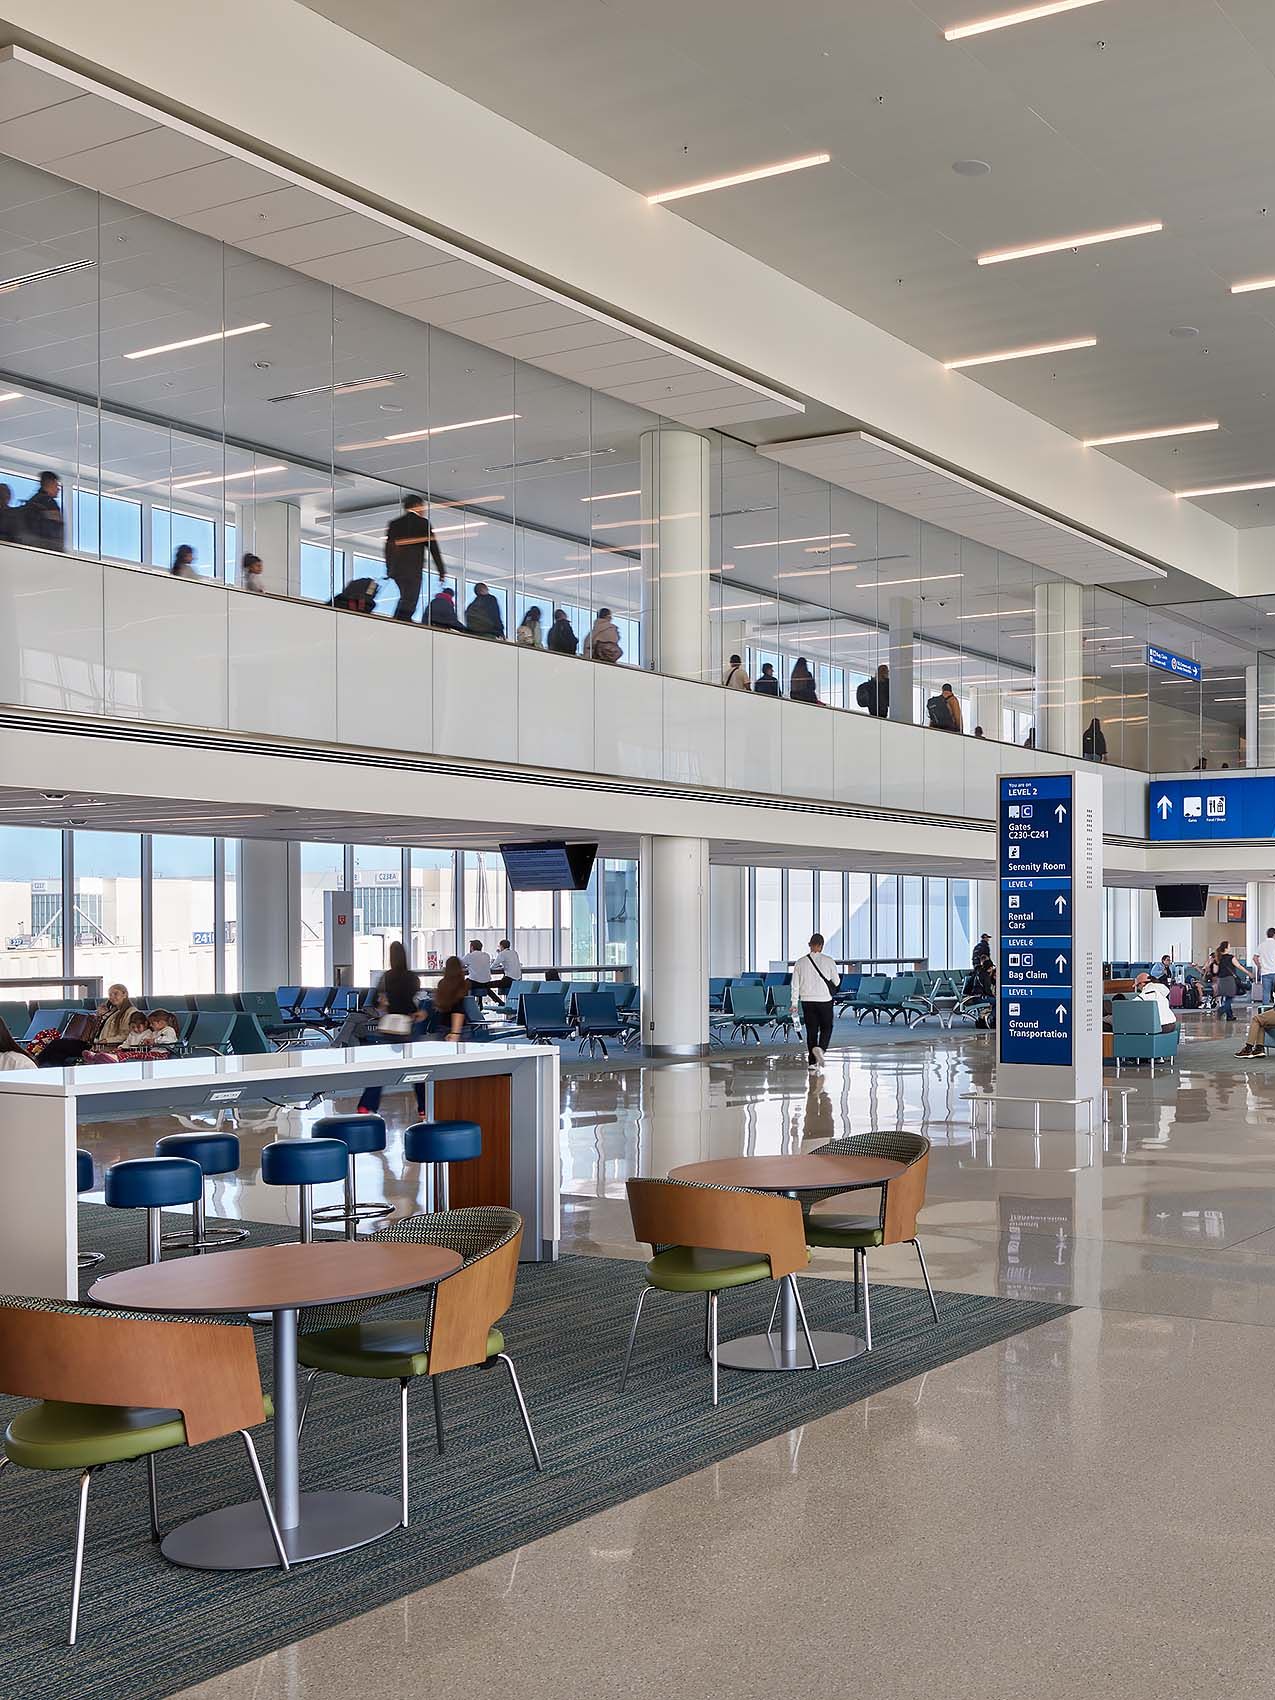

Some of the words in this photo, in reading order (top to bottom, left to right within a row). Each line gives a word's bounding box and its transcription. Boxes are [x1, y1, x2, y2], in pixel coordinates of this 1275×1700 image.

[1009, 823, 1032, 831] Gates
[1009, 831, 1049, 839] C230-C241
[1008, 863, 1041, 872] Serenity
[1009, 912, 1034, 921] Rental
[1009, 921, 1026, 929] Cars
[1009, 971, 1024, 980] Bag
[1026, 970, 1048, 979] Claim
[1009, 1020, 1039, 1029] Ground
[1009, 1029, 1068, 1039] Transportation
